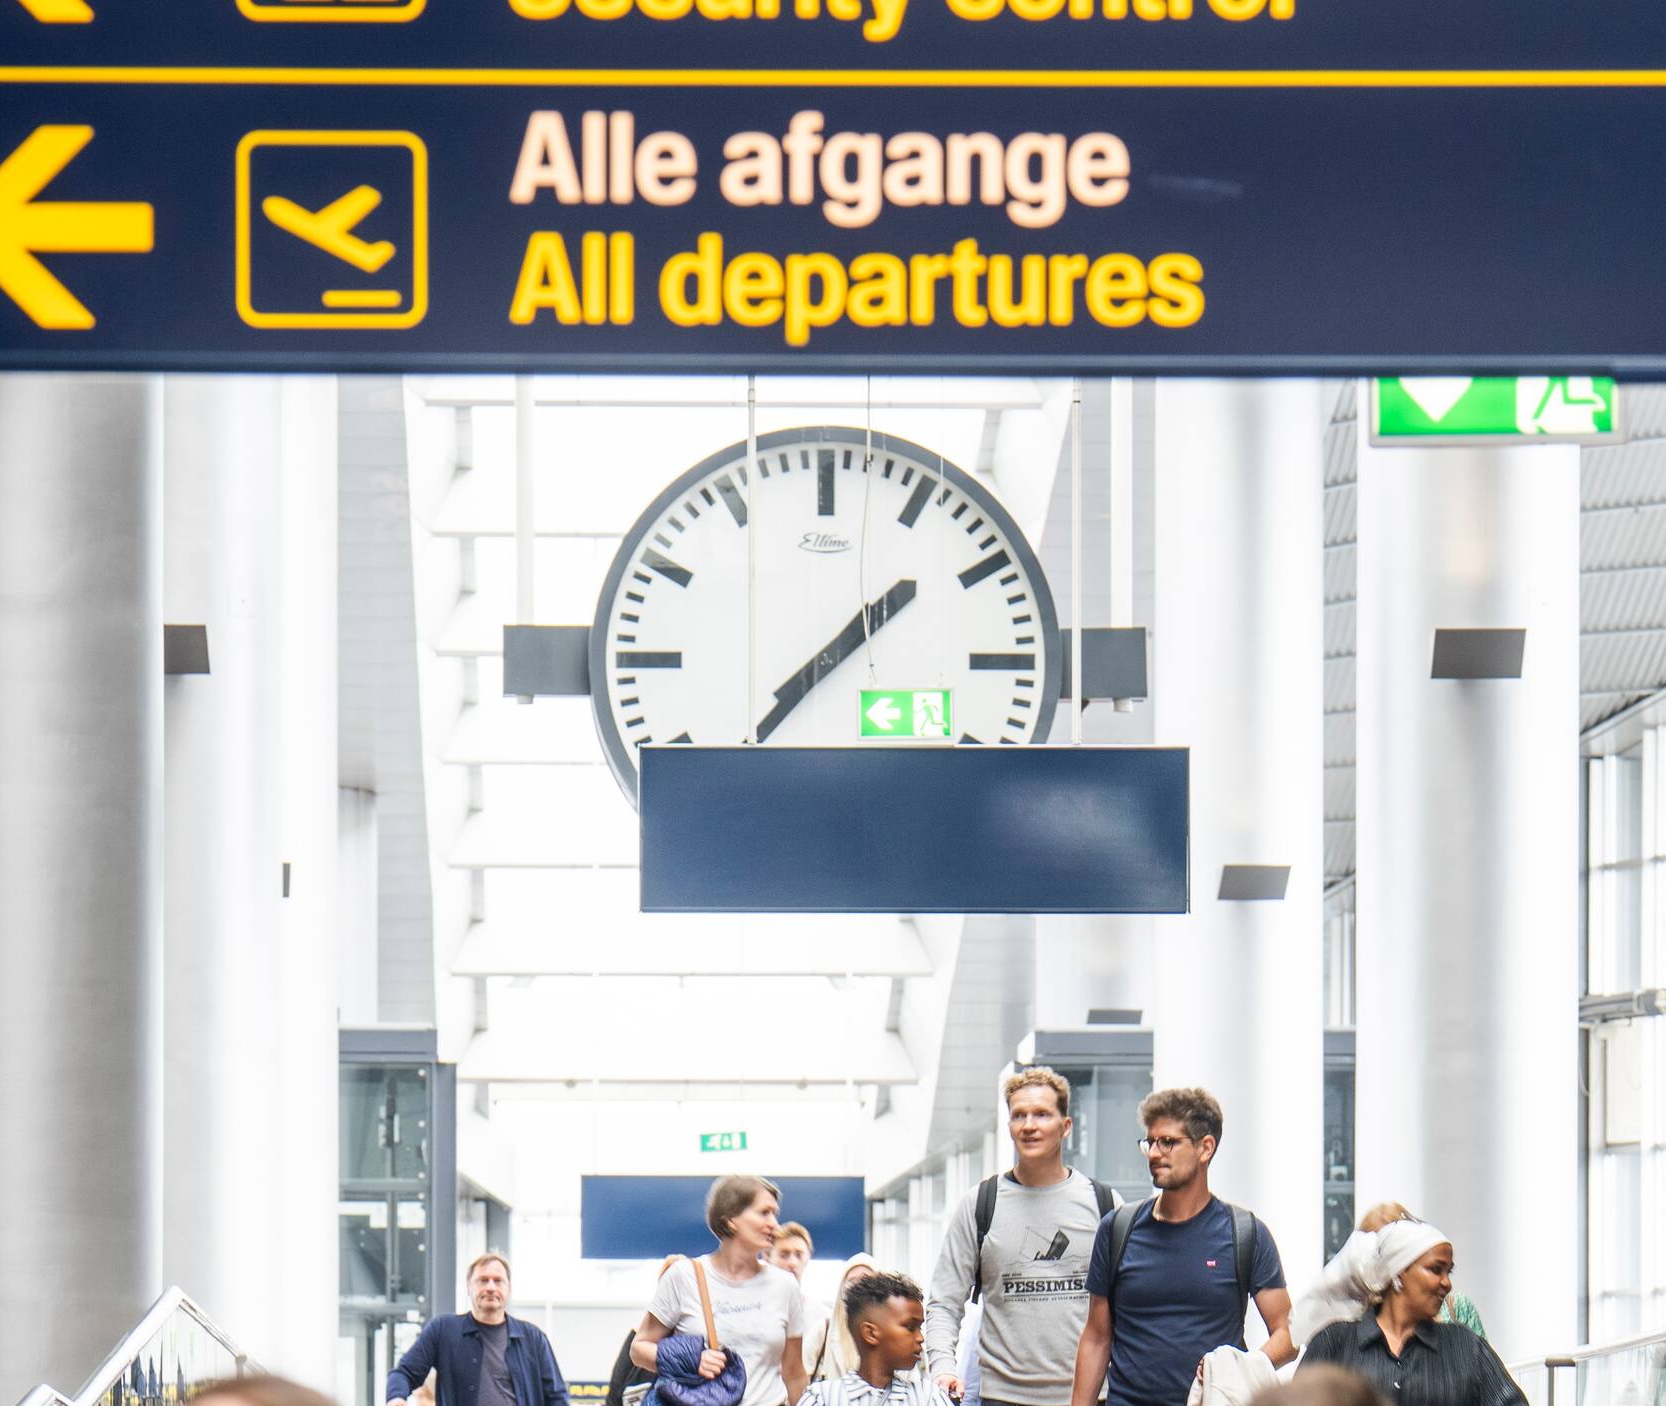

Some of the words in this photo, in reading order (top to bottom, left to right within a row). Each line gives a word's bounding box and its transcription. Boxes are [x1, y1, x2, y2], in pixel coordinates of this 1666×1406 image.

[509, 110, 698, 207] Alle
[719, 109, 1132, 229] afgange
[508, 230, 635, 326] All
[658, 231, 1206, 348] departures
[1003, 1279, 1085, 1294] PESSIMIS
